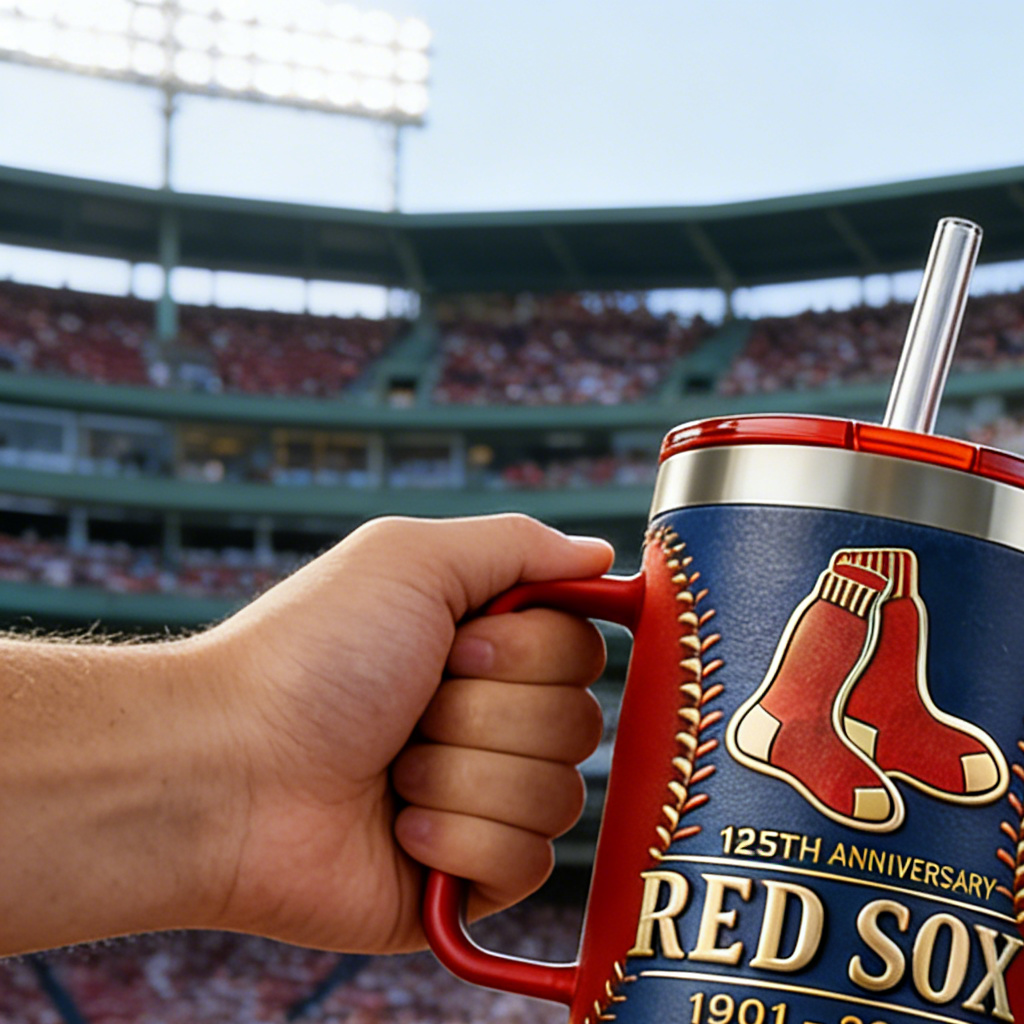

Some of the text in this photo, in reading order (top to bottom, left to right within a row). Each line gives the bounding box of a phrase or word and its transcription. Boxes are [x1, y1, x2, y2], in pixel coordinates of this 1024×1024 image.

[720, 826, 999, 901] 125TH ANNIVERSARY
[626, 870, 1024, 1022] RED SOX
